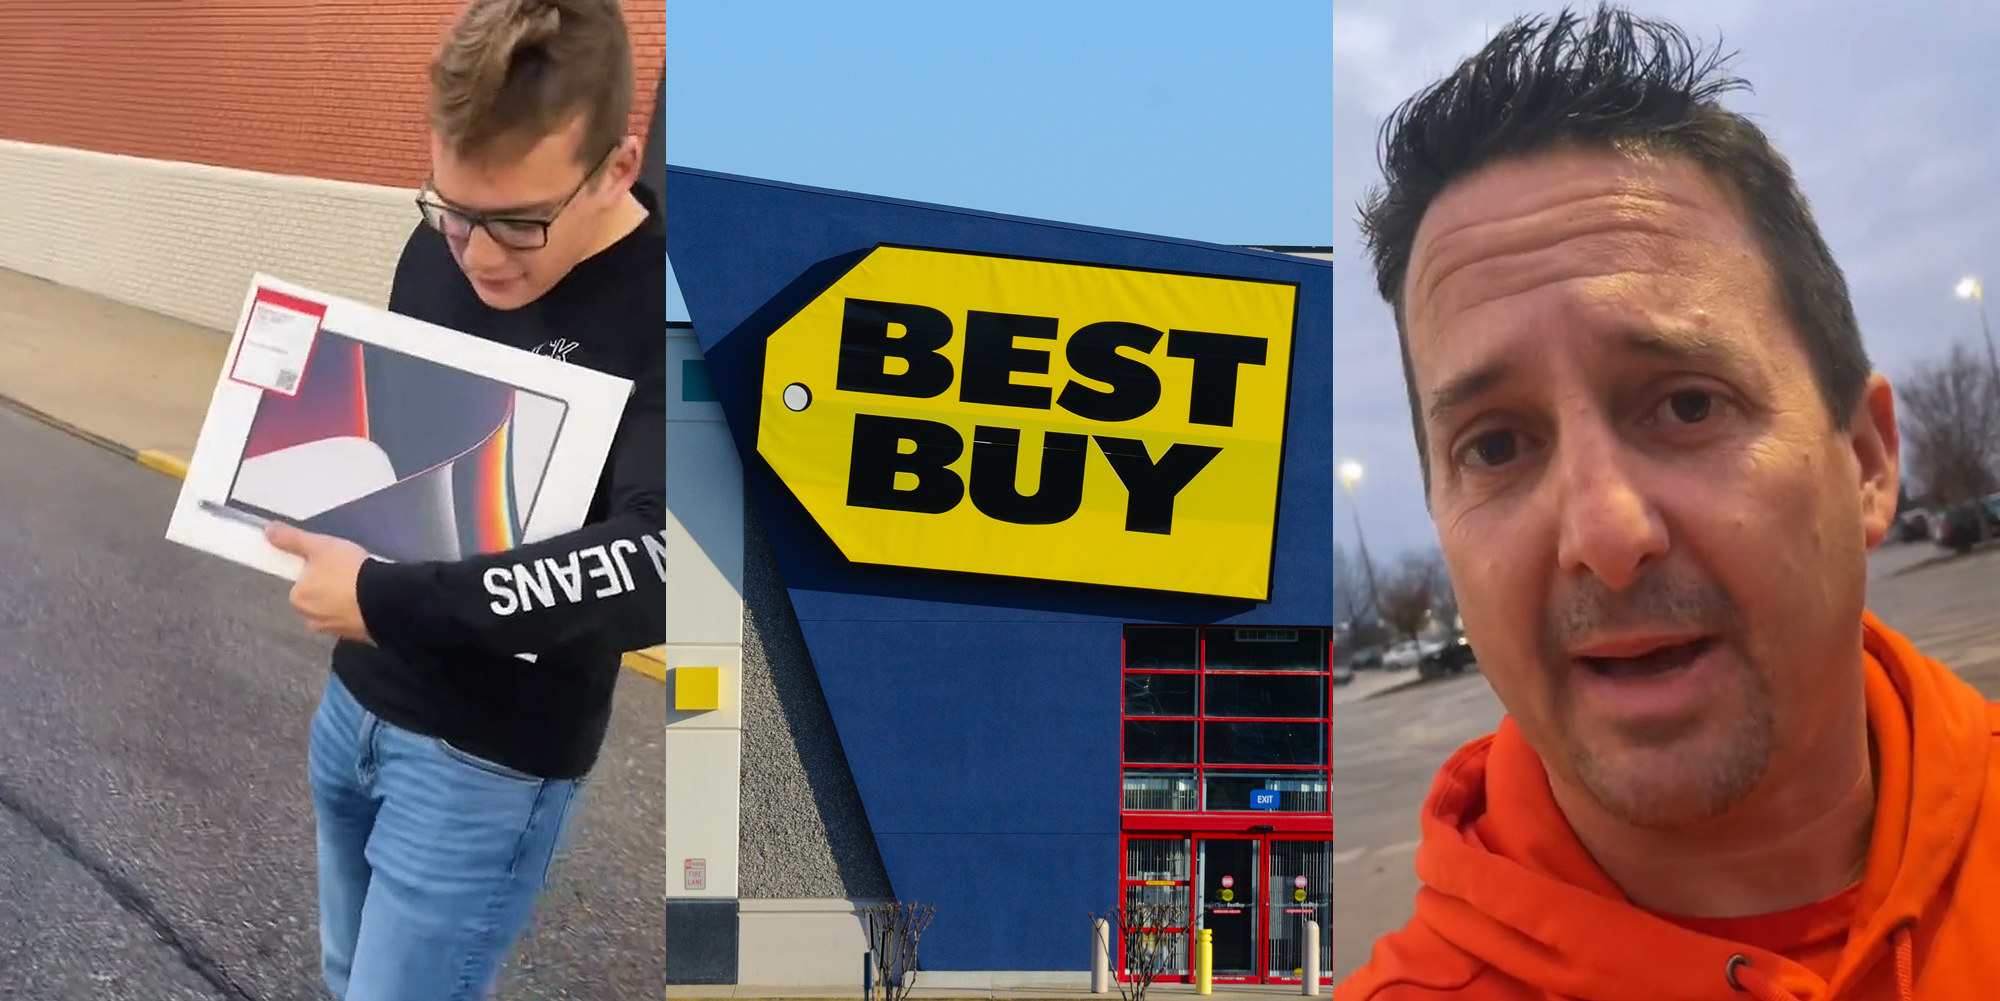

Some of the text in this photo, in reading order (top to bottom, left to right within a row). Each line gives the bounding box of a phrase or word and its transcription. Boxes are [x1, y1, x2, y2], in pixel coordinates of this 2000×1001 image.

[836, 297, 1268, 427] BEST
[846, 413, 1224, 535] BUY
[483, 539, 637, 616] JEANS
[1257, 795, 1273, 804] EXIT
